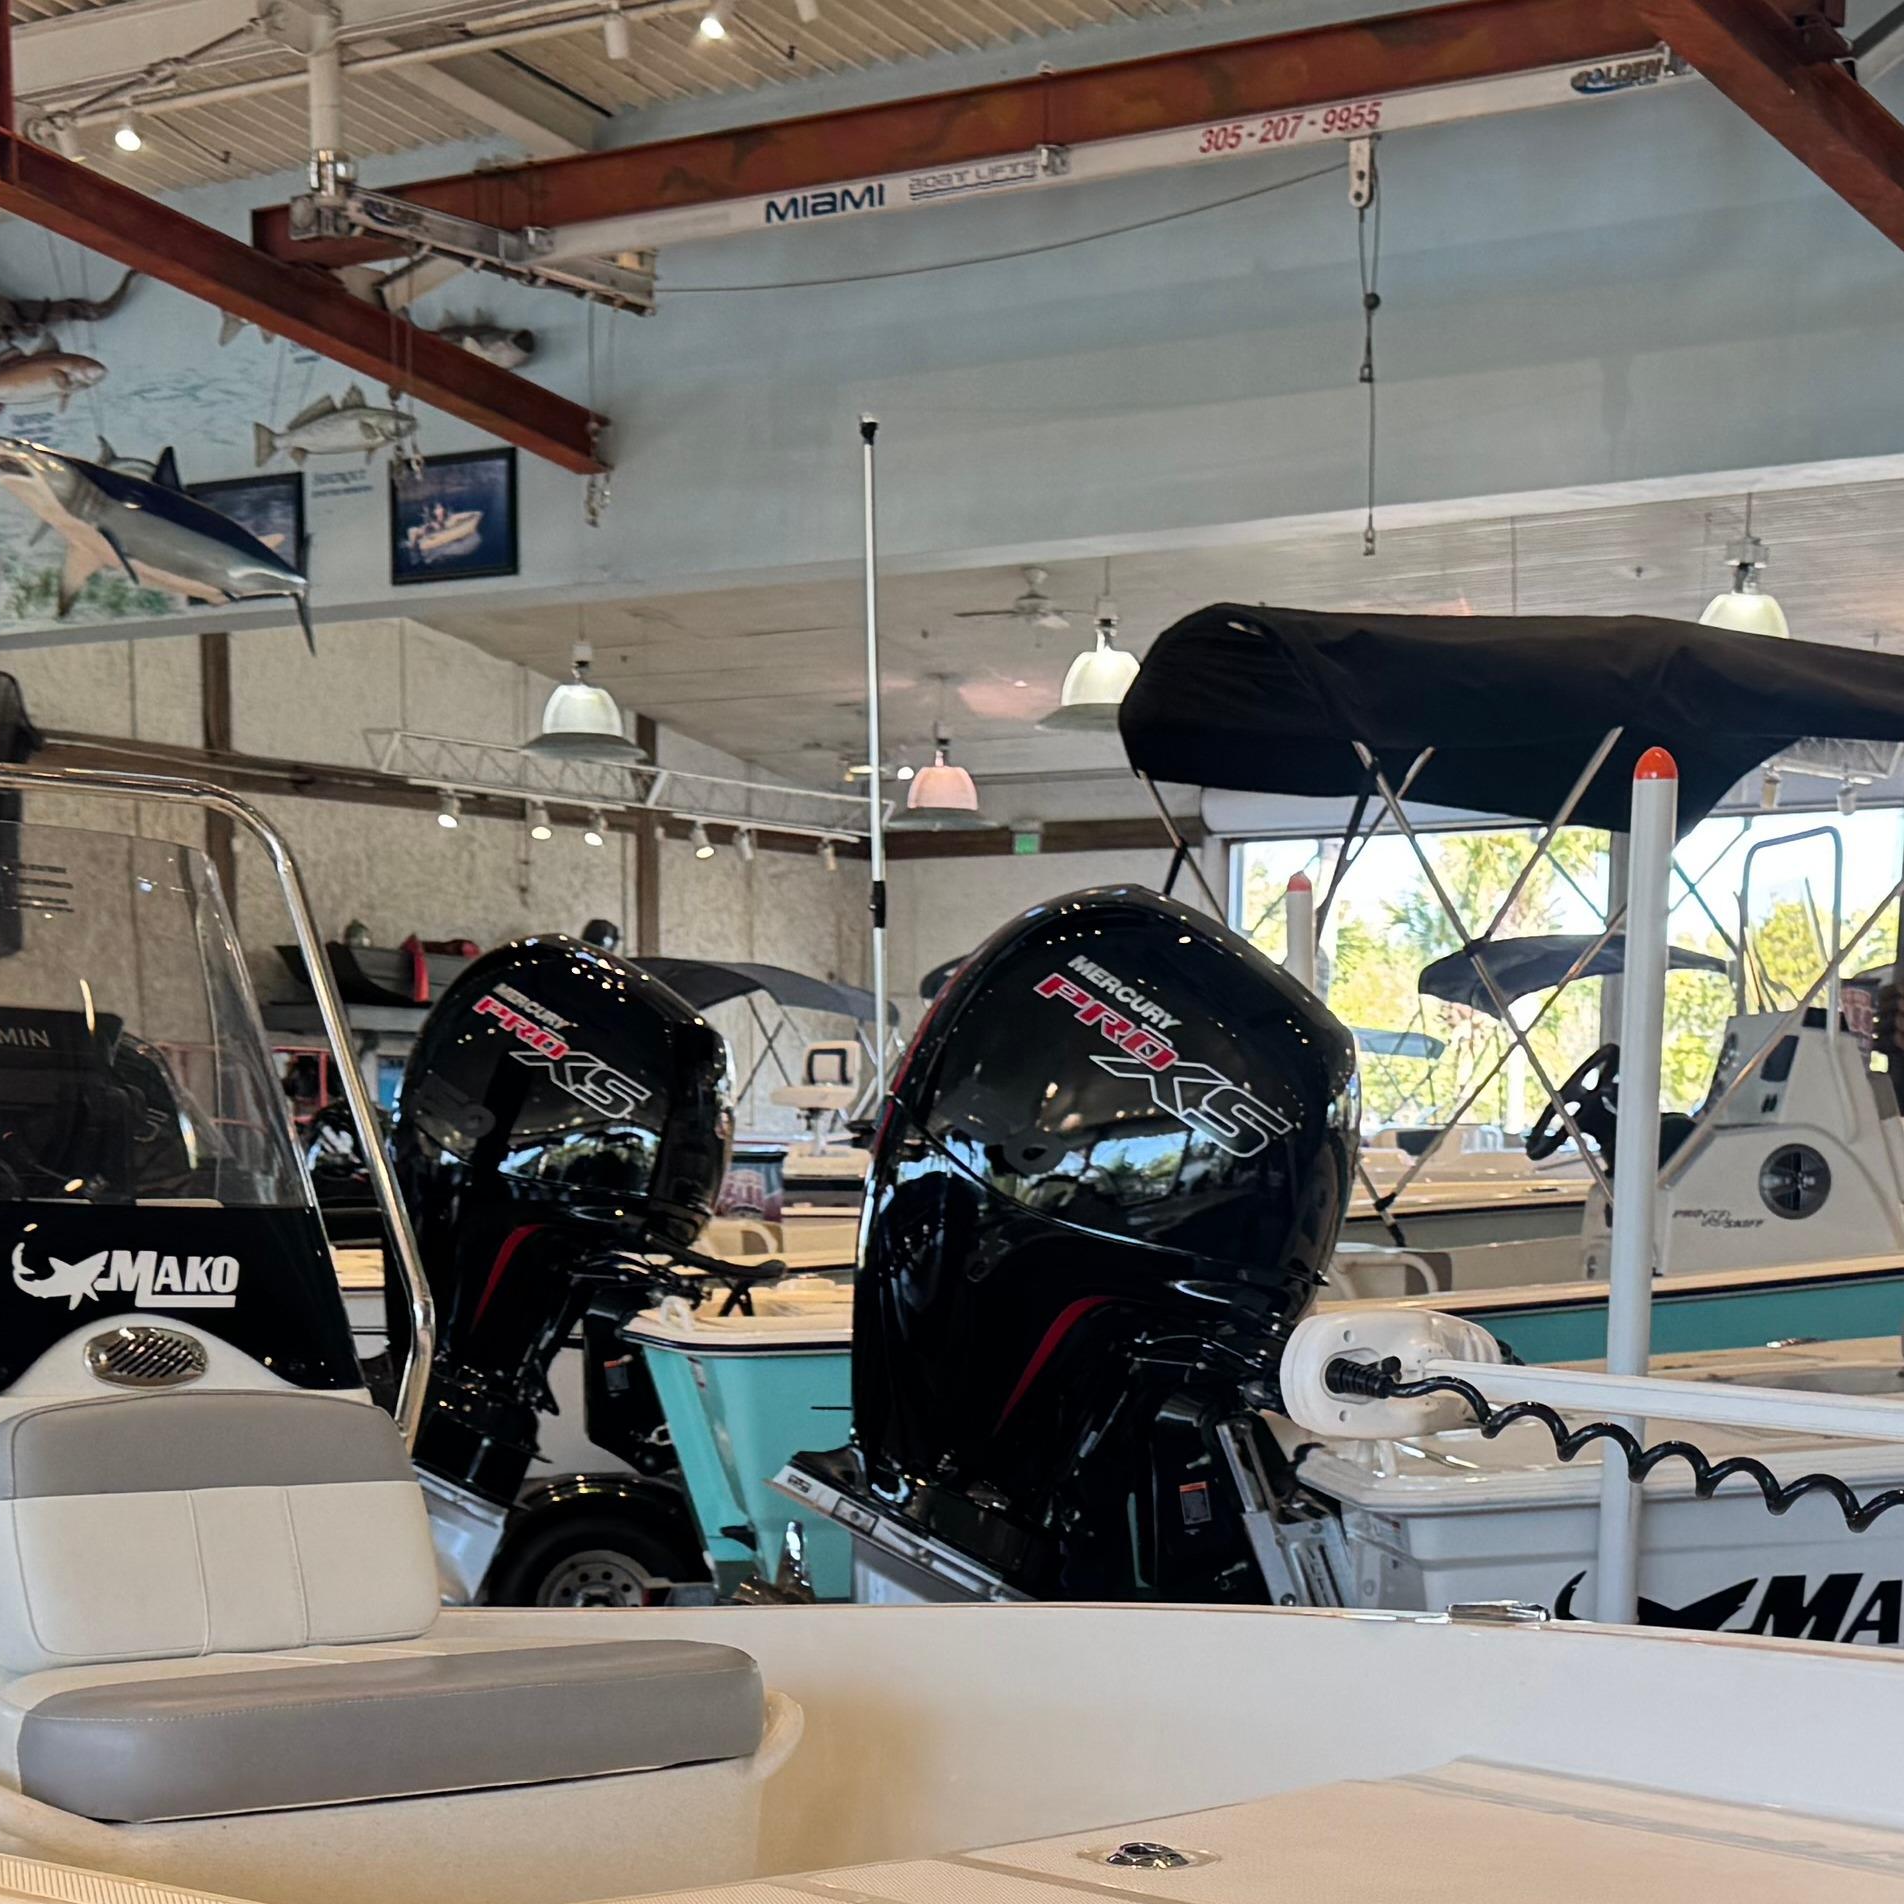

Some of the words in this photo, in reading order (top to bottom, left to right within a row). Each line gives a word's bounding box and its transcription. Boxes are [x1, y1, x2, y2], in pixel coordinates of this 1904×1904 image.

[472, 995, 570, 1061] PRO
[1033, 972, 1179, 1072] PRO
[1067, 954, 1182, 1030] MERCURY
[509, 1051, 652, 1119] XS
[1089, 1054, 1294, 1157] XS
[95, 1249, 240, 1308] MAKO
